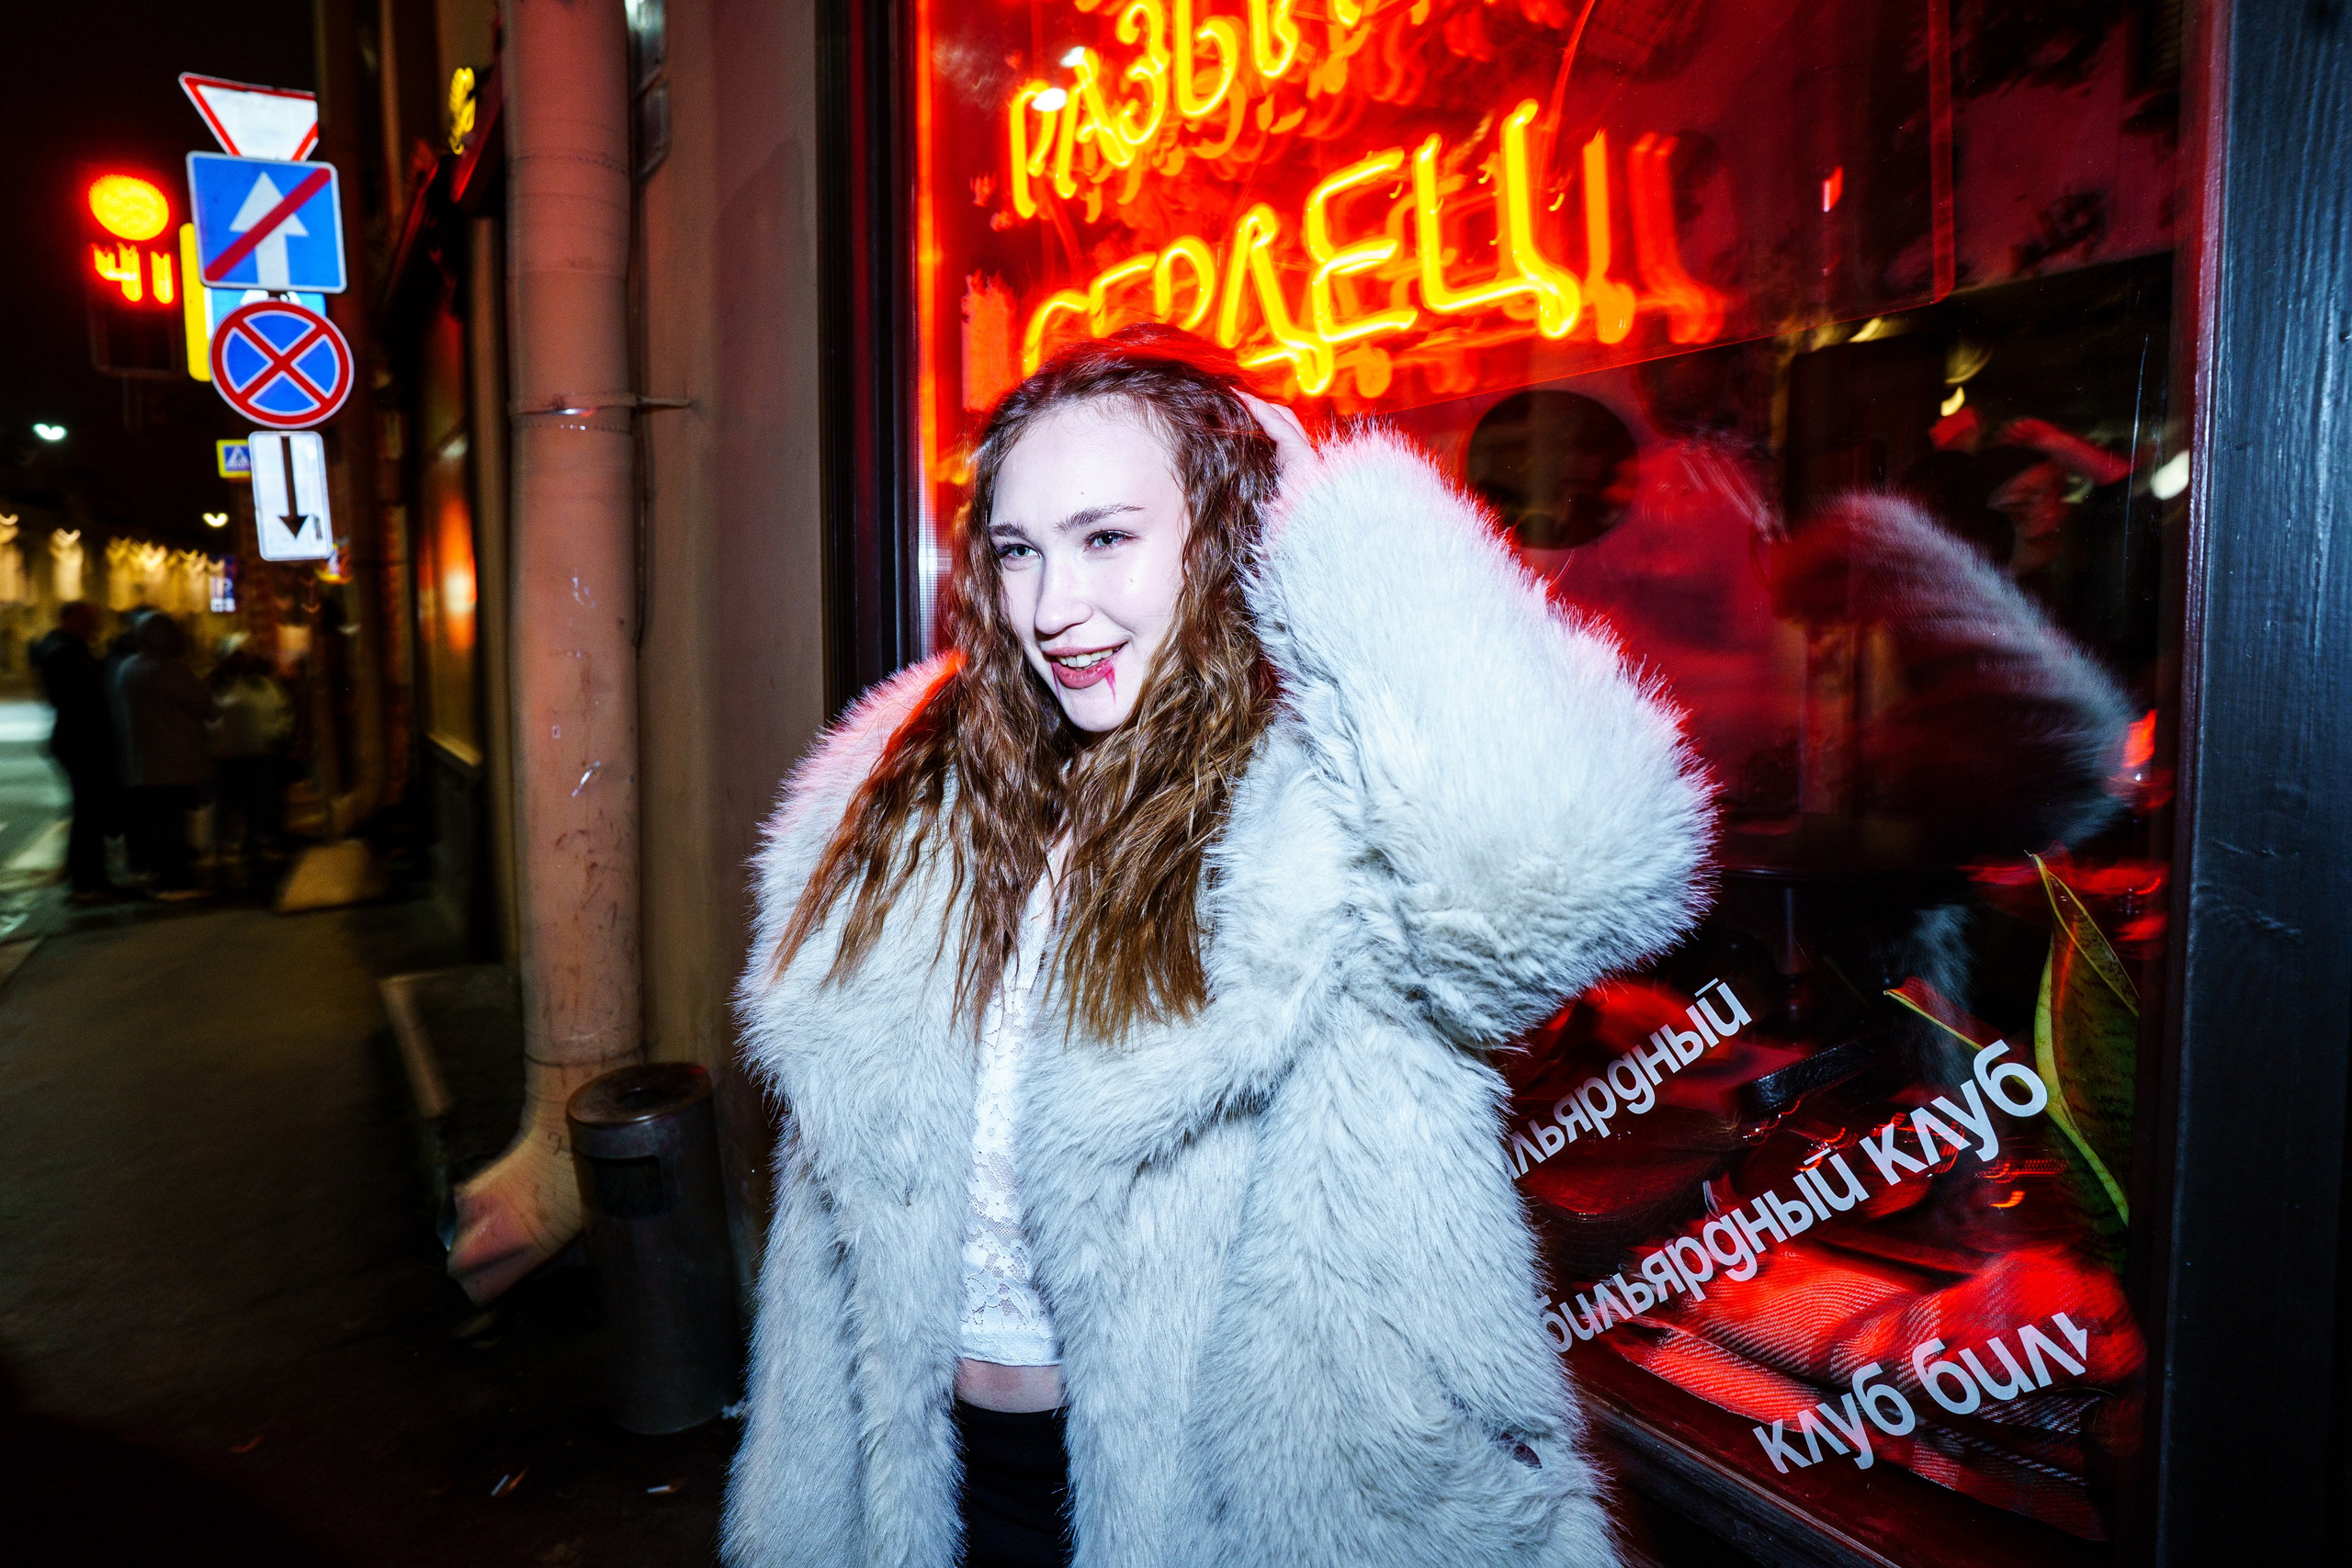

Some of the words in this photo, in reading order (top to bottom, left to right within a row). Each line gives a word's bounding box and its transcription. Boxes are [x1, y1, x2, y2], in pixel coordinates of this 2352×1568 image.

[92, 243, 174, 305] 41
[1509, 977, 1752, 1179] льярдный
[1538, 1147, 1870, 1353] бильярдный
[1860, 1039, 2048, 1186] клуб
[1753, 1361, 1916, 1473] клуб
